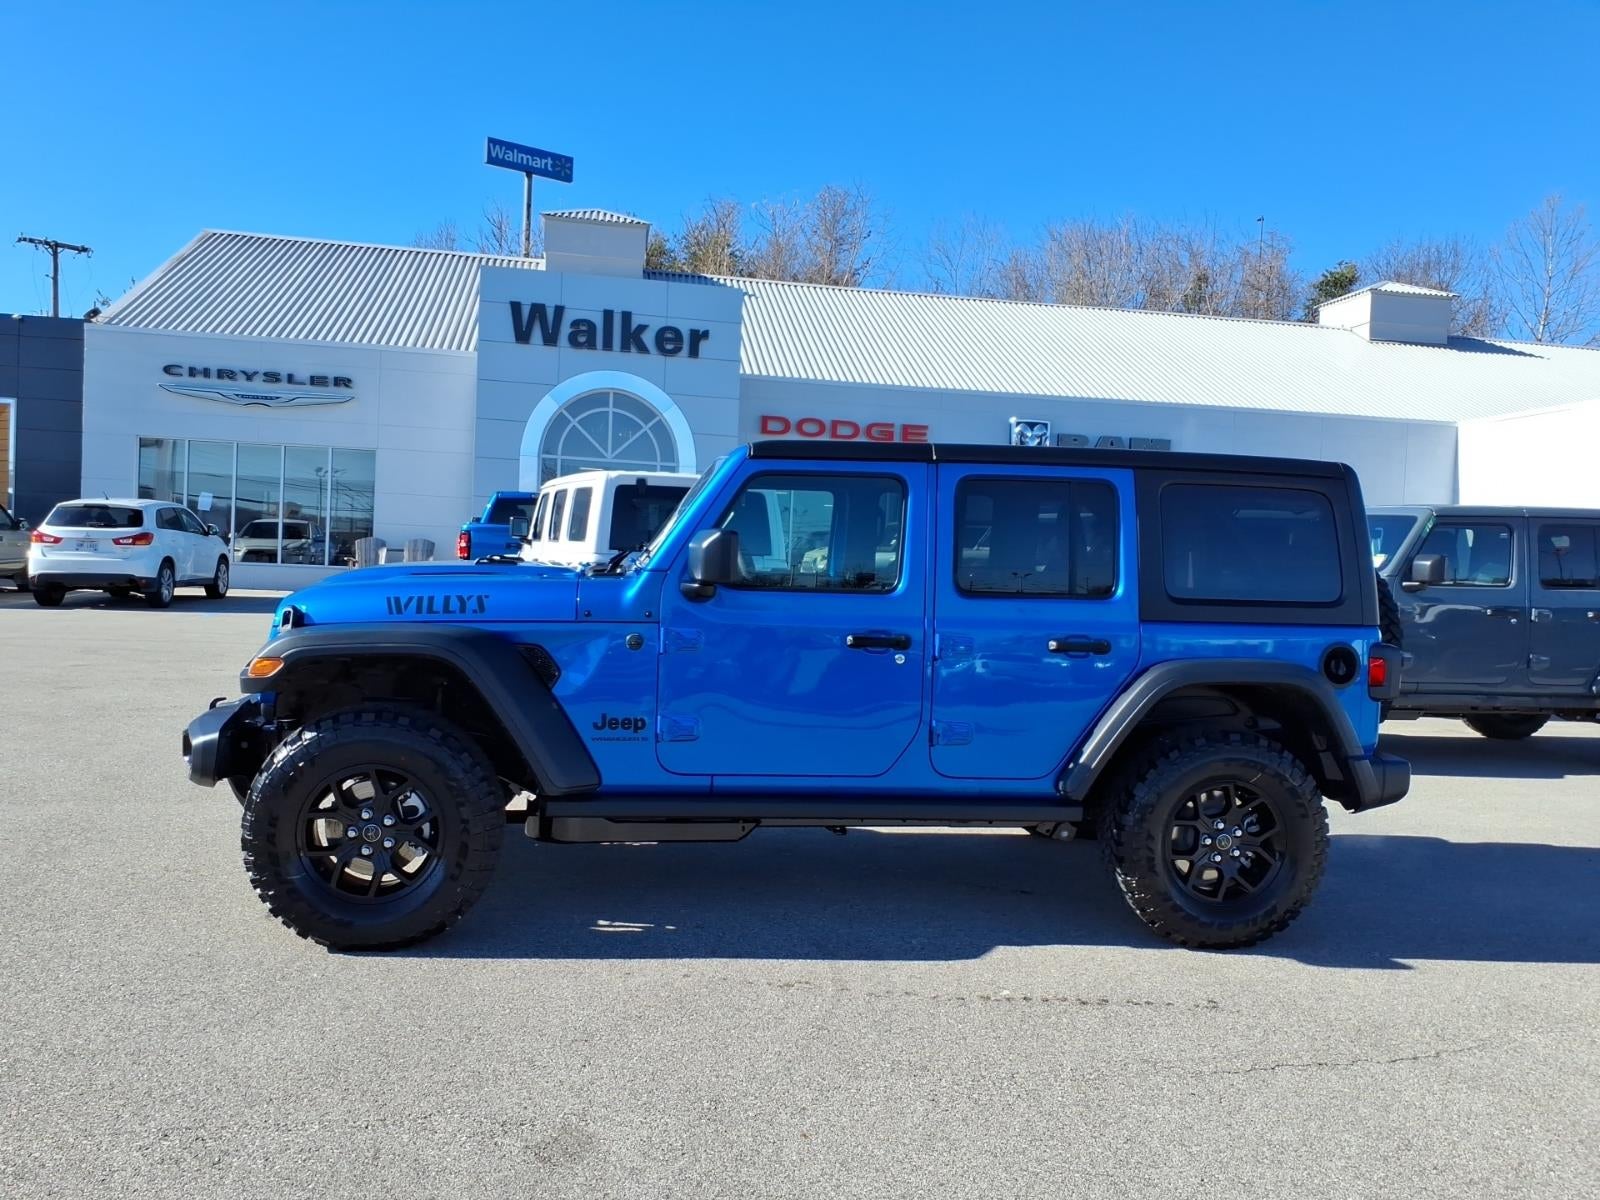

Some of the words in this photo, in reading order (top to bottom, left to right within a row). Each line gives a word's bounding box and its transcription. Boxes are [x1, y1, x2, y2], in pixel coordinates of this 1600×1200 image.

[489, 143, 553, 171] Walmart
[509, 300, 709, 358] Walker
[162, 364, 353, 388] CHRYSLER
[760, 415, 928, 442] DODGE
[385, 595, 490, 615] WILLYS
[592, 713, 647, 734] Jeep
